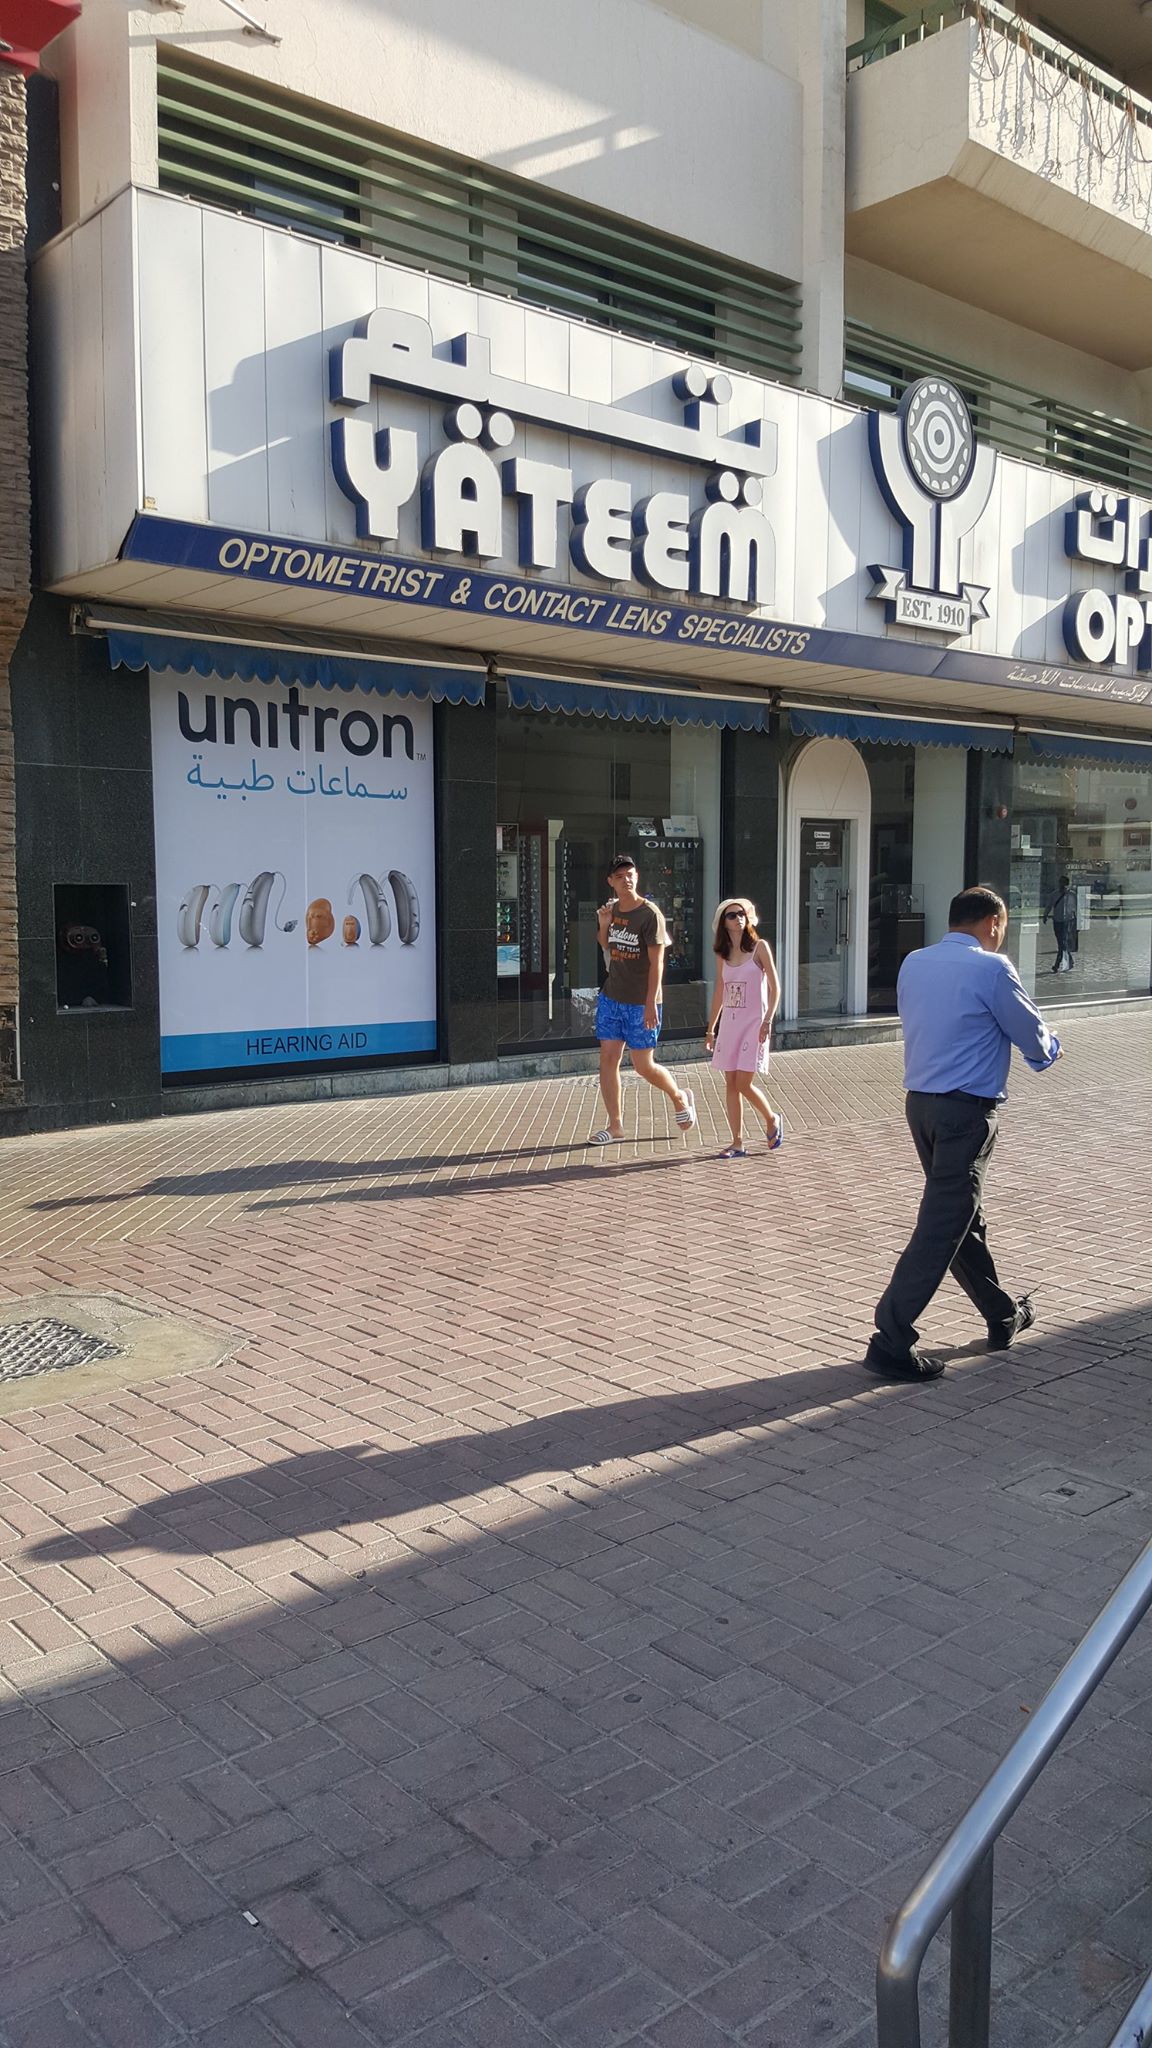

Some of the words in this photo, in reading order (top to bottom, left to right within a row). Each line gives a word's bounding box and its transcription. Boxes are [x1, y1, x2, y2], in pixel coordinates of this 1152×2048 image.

[219, 538, 444, 600] OPTOMETRIST
[450, 578, 472, 605] &
[484, 583, 606, 624] CONTACT
[606, 603, 672, 635] LENS
[678, 614, 811, 655] SPECIALISTS
[901, 597, 932, 621] EST.
[937, 604, 965, 627] 1910
[1064, 588, 1152, 666] OP
[178, 687, 414, 761] unitron
[187, 754, 275, 801] طبية
[287, 763, 408, 800] سماعات
[246, 1033, 333, 1056] HEARING
[338, 1032, 368, 1050] AID
